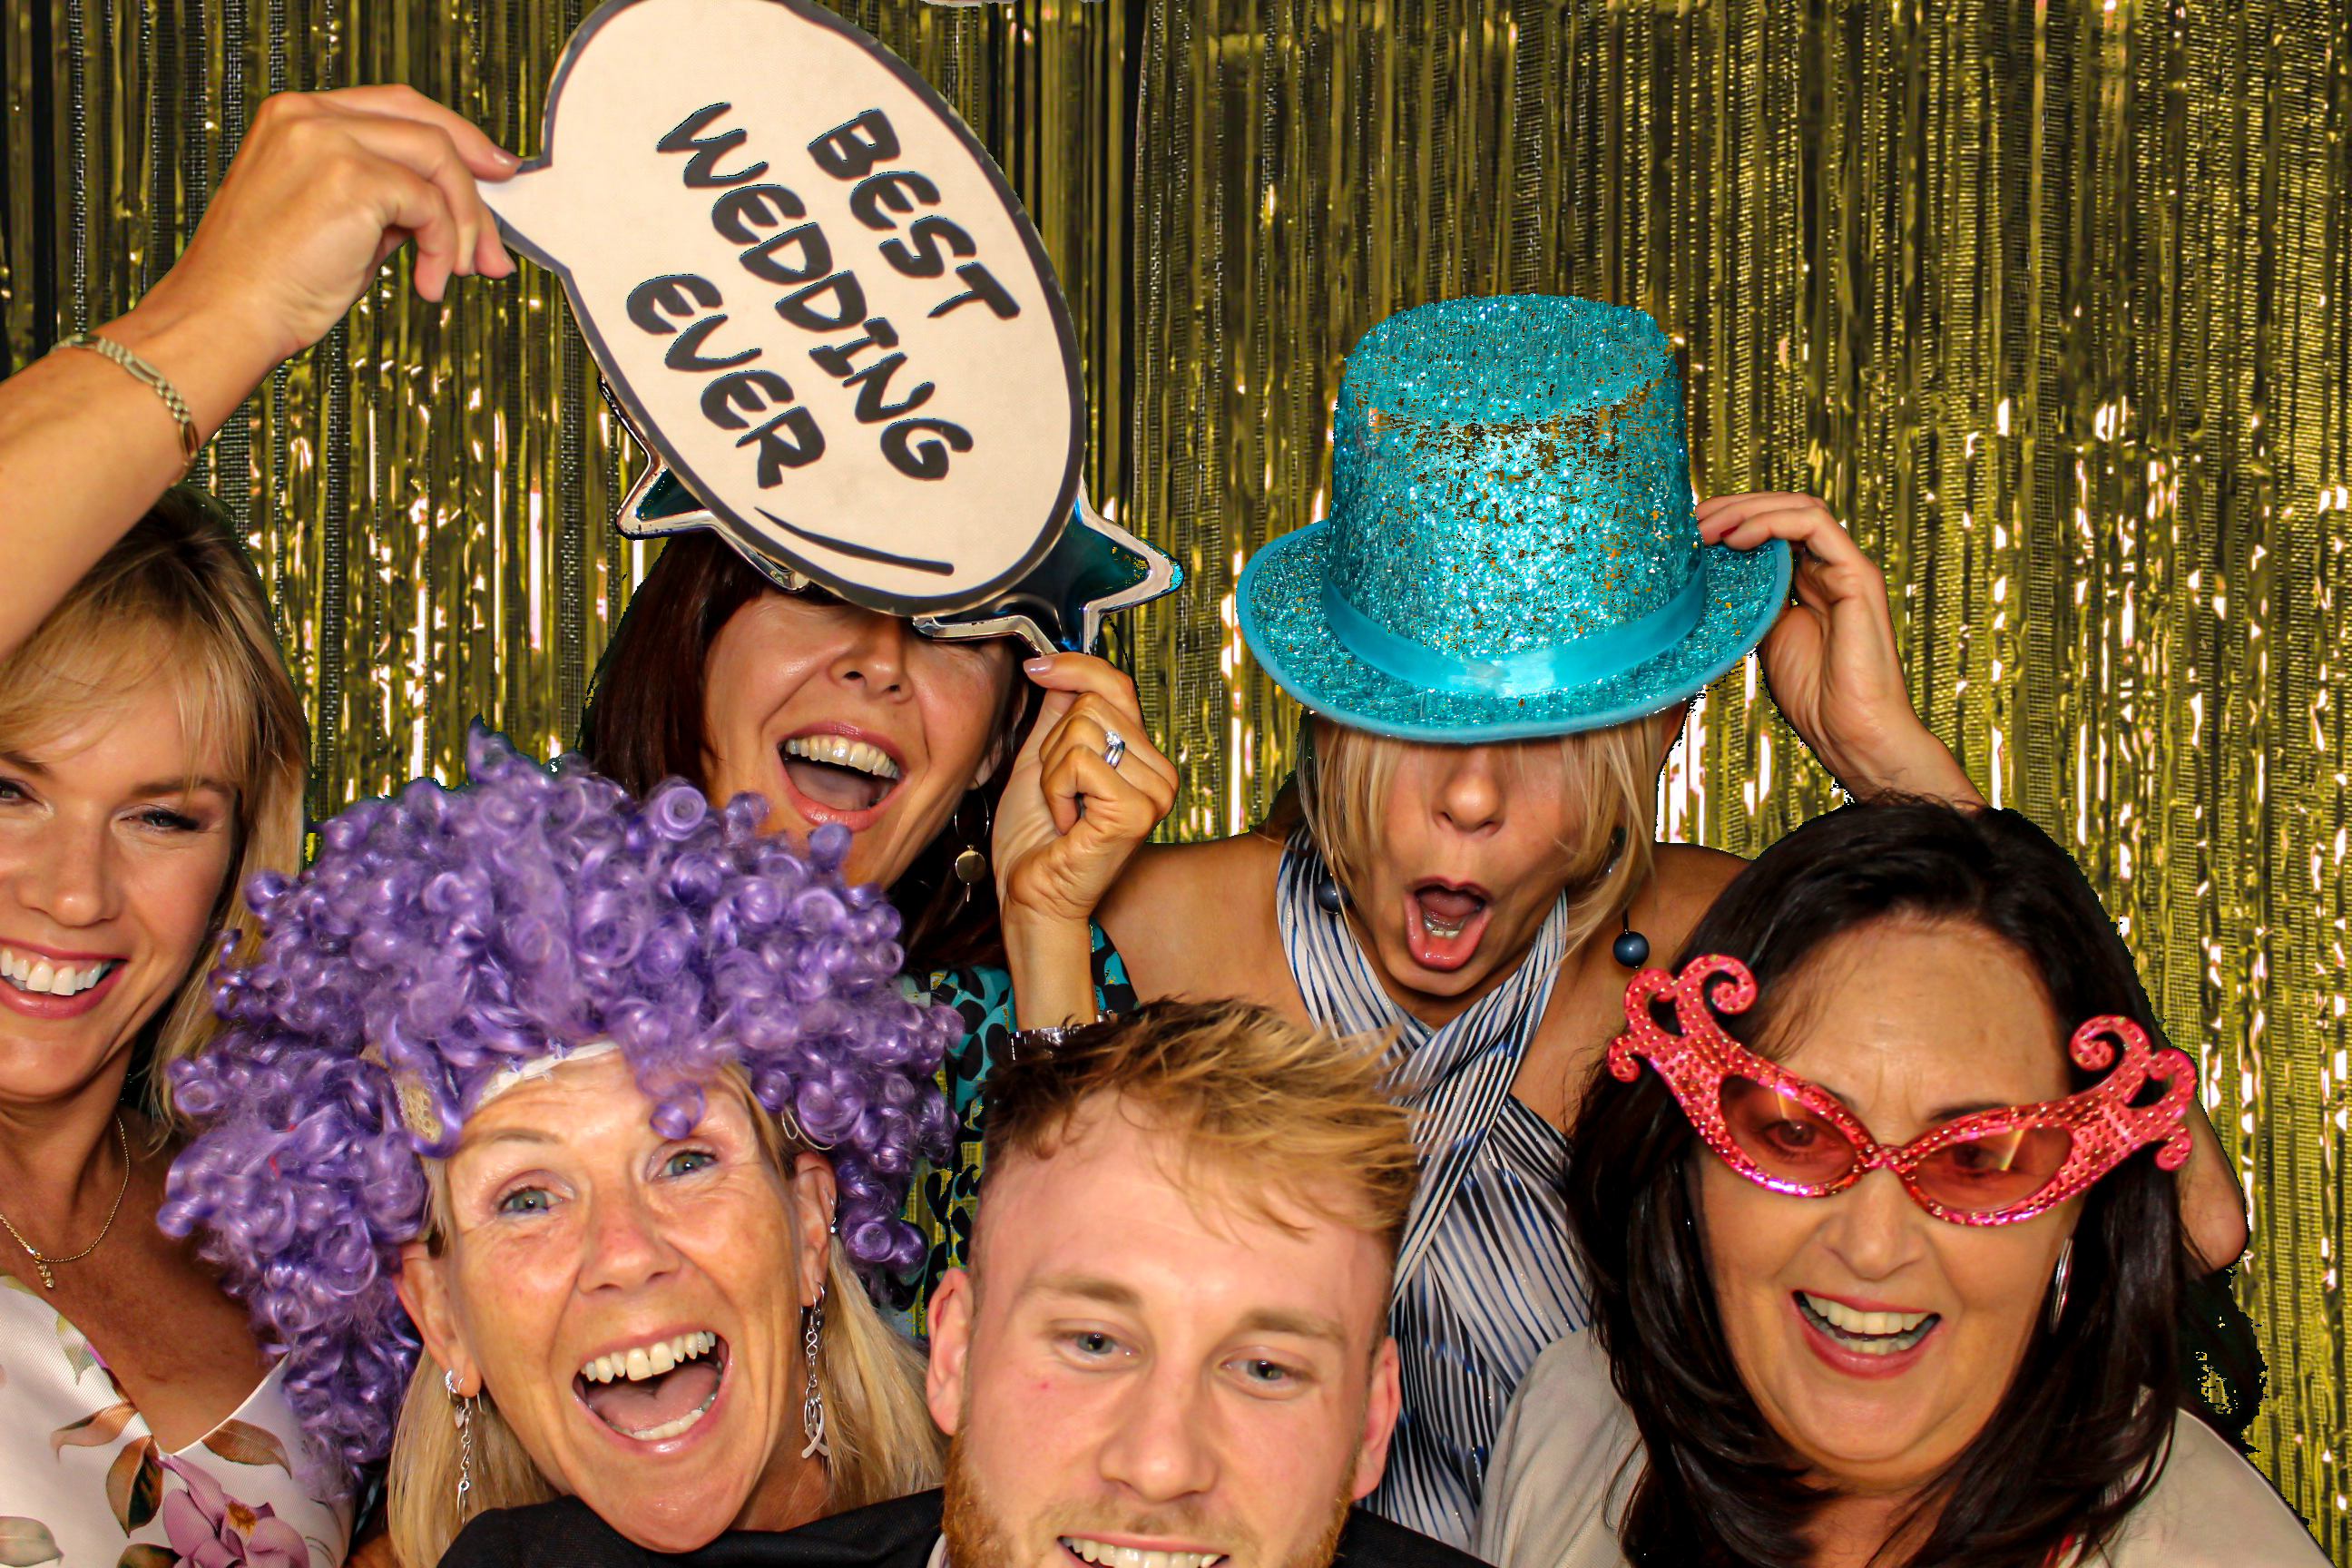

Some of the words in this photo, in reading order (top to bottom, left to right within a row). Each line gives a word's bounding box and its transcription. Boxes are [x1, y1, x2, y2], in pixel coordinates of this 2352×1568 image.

[657, 103, 973, 480] WEDDING
[808, 109, 1020, 319] BEST
[627, 275, 825, 489] EVER
